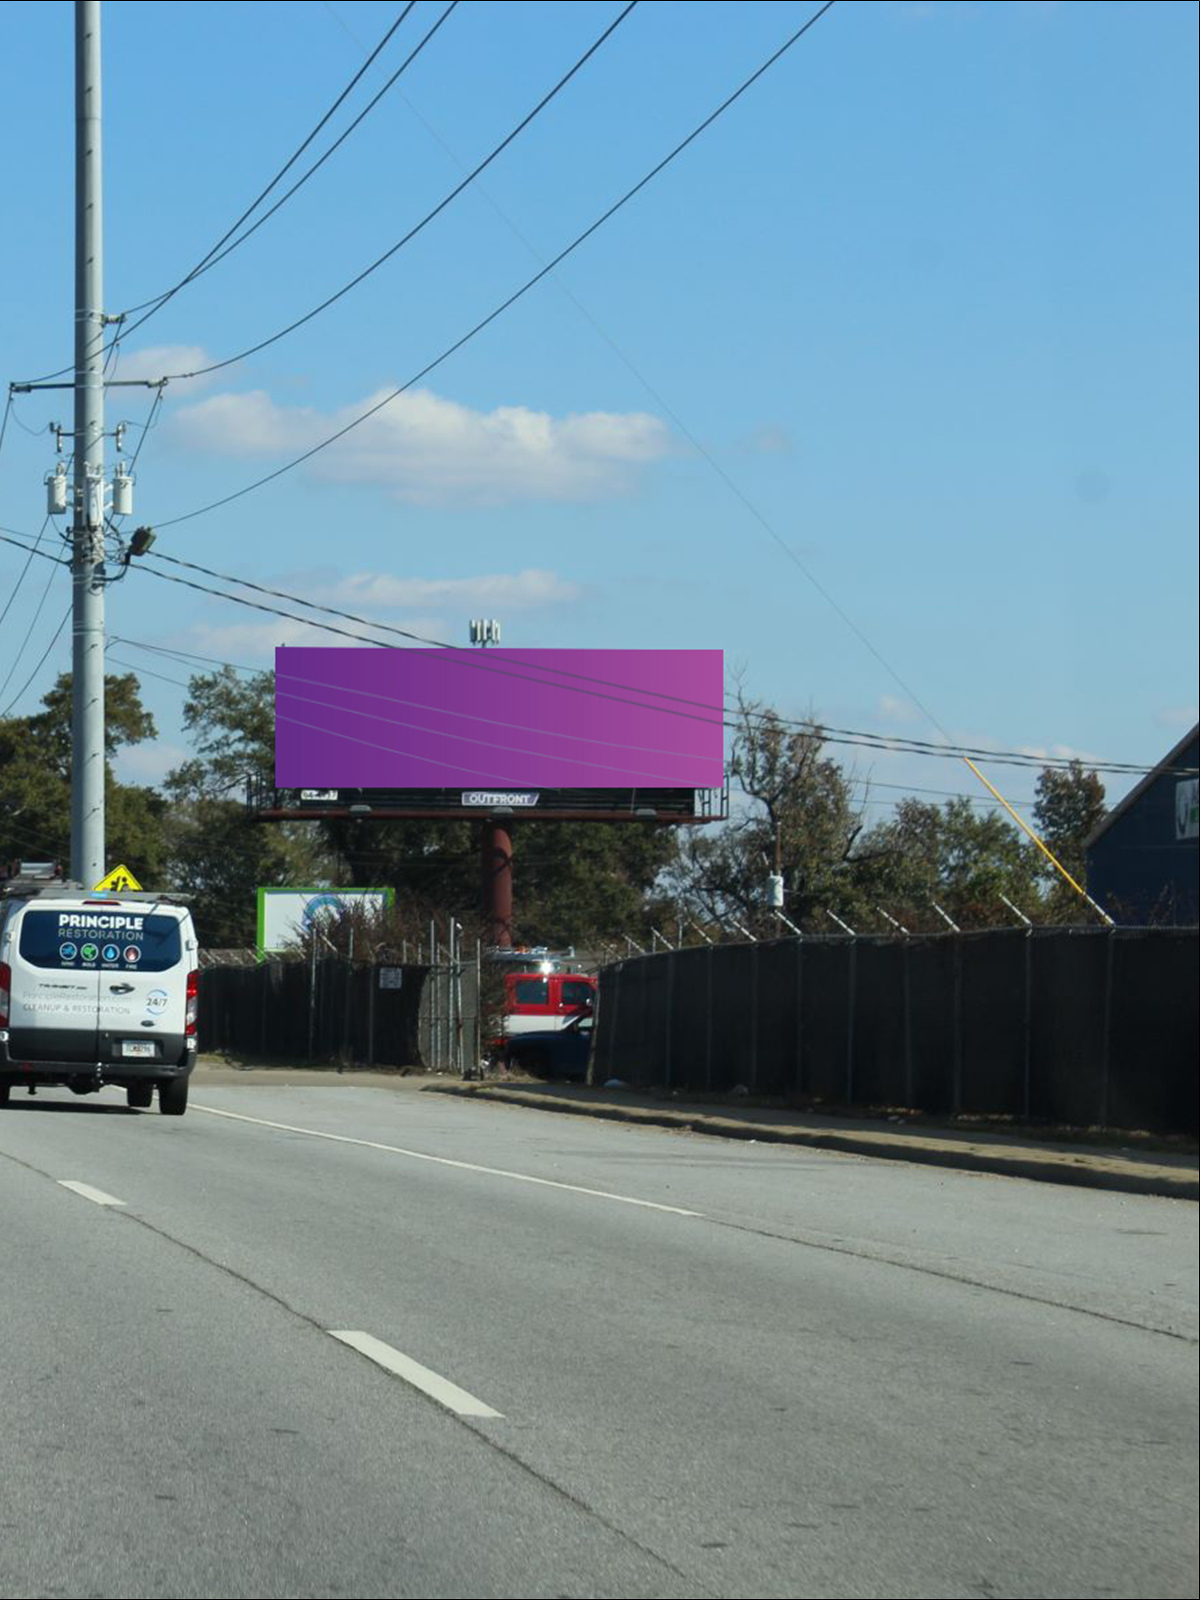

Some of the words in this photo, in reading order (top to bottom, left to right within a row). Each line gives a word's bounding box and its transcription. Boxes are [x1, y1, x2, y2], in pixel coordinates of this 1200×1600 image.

[469, 793, 531, 804] OUTFRONT
[58, 914, 144, 930] PRINCIPLE
[57, 927, 144, 940] RESTORATION
[22, 1002, 61, 1012] CLEANUP
[64, 1004, 70, 1012] &
[146, 997, 168, 1007] 24/7
